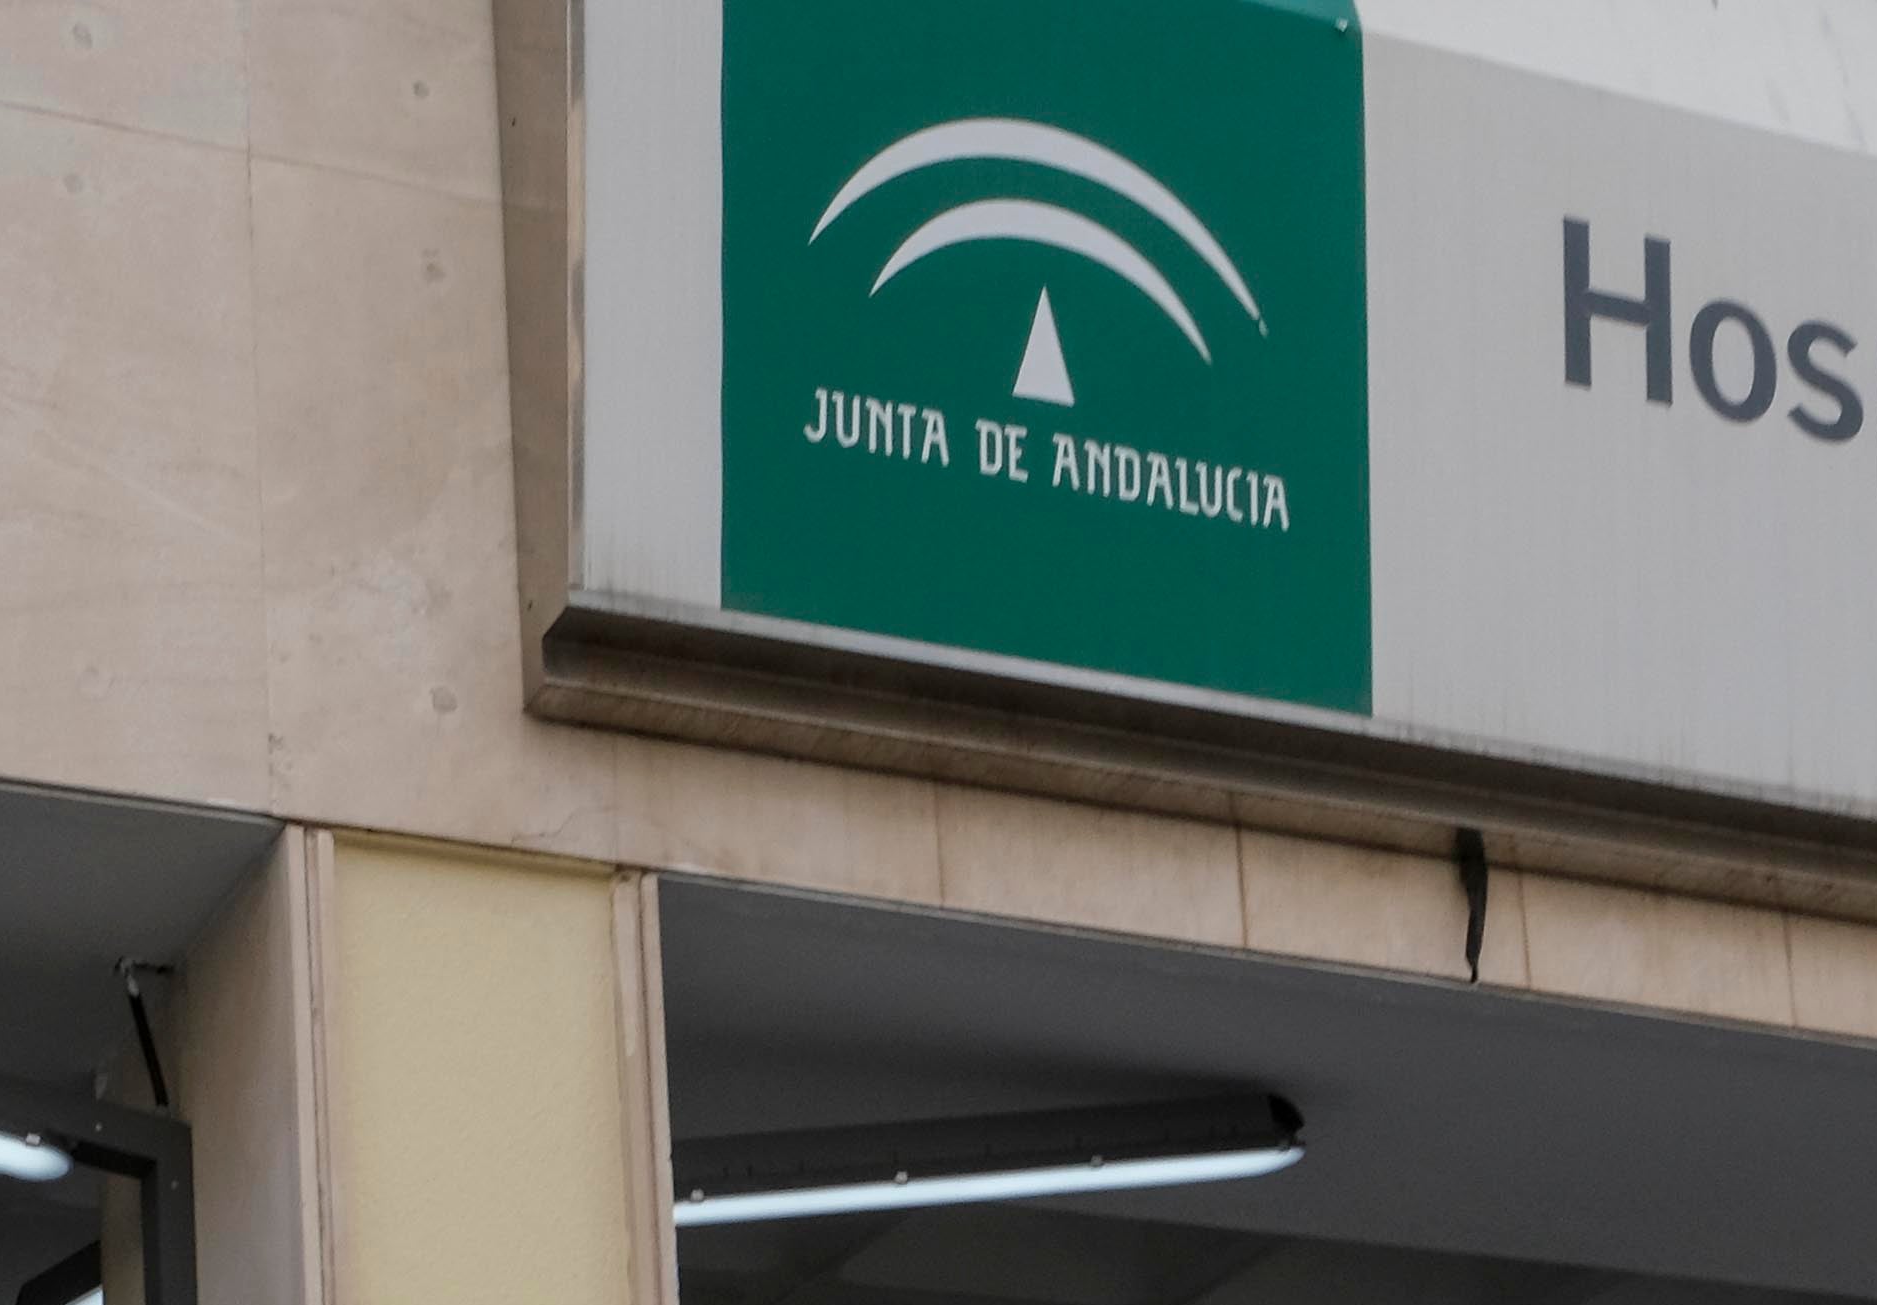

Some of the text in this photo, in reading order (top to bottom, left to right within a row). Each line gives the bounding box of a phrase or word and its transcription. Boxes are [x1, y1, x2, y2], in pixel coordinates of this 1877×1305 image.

[804, 387, 1290, 532] JUNTA DE ANDALUCIA
